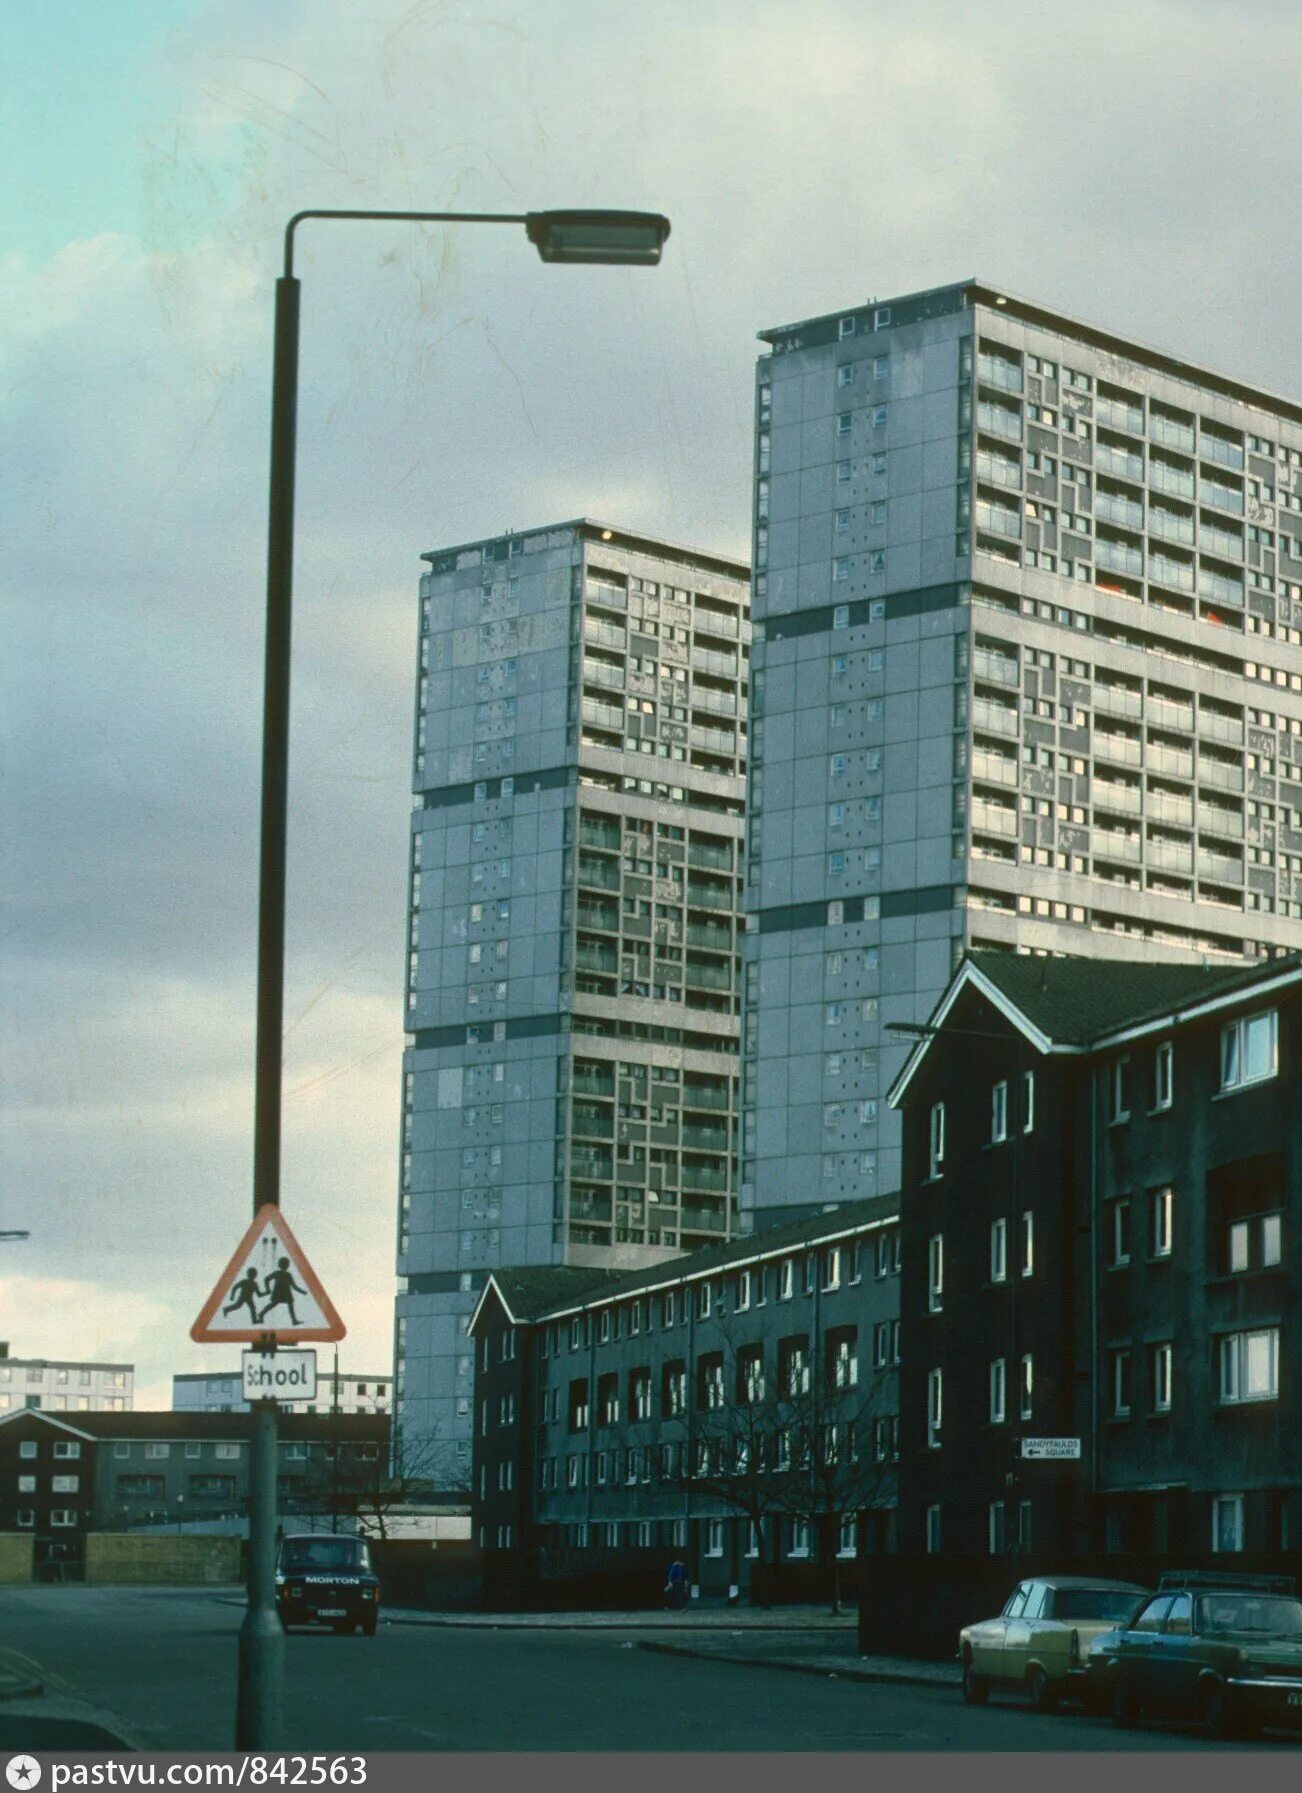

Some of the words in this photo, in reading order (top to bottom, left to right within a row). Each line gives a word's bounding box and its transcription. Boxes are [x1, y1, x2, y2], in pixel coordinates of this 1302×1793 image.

[247, 1363, 307, 1385] School
[1024, 1440, 1078, 1448] SANDYFAULDS
[1045, 1448, 1076, 1457] SQUARE
[305, 1576, 360, 1585] MORTON
